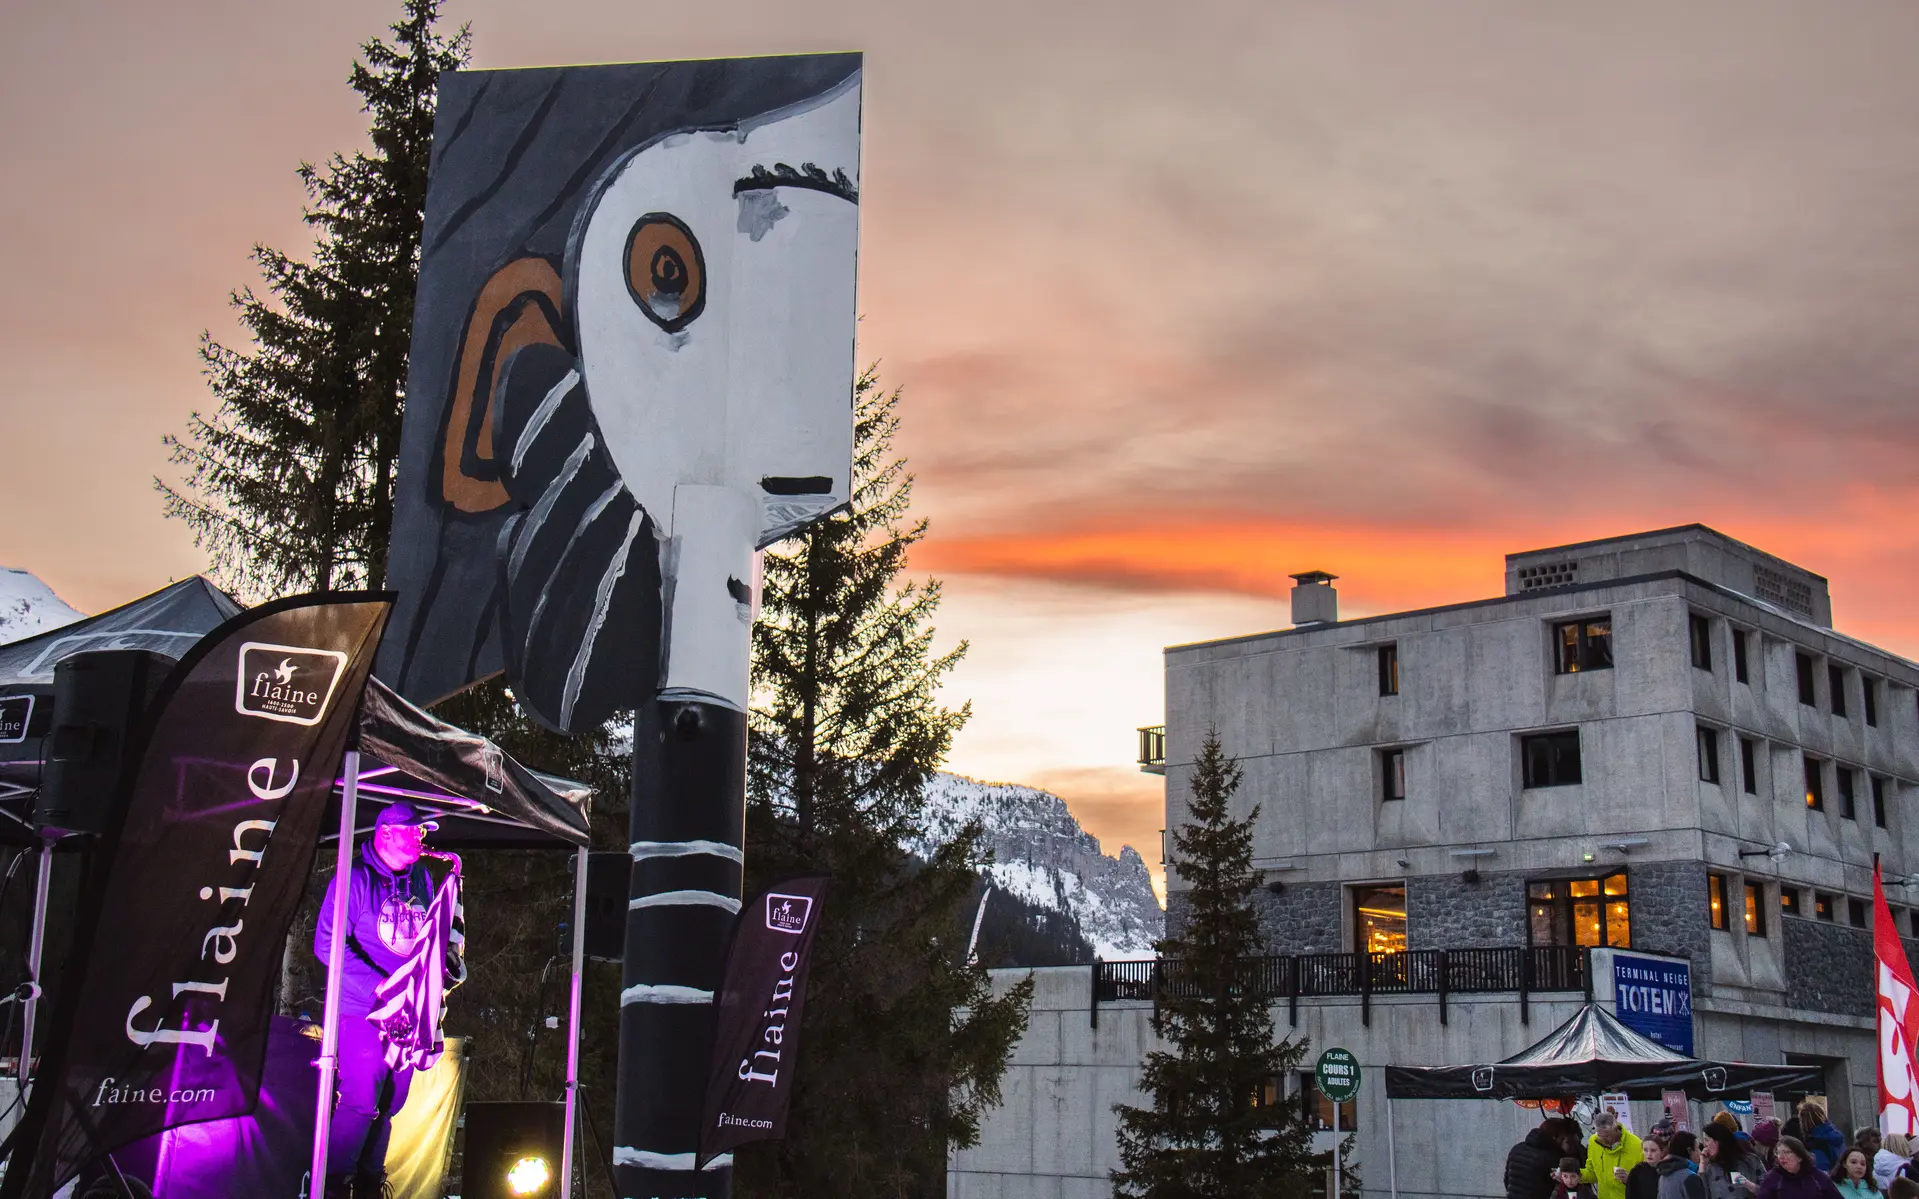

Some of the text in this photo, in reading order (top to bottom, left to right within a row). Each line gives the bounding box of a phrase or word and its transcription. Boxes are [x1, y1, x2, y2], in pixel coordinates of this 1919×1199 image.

[250, 672, 318, 705] flaine
[261, 704, 297, 714] HAUTE-SAVOIE
[126, 758, 299, 1057] flaine
[772, 907, 801, 925] flaine
[1616, 966, 1688, 986] TERMINAL NEIGE
[1618, 984, 1677, 1016] TOTEM
[738, 951, 798, 1088] flaine
[1326, 1052, 1349, 1061] FLAINE
[1322, 1063, 1354, 1076] COURS 1
[1327, 1077, 1351, 1086] ADULTES
[1729, 1101, 1753, 1112] ENFAN
